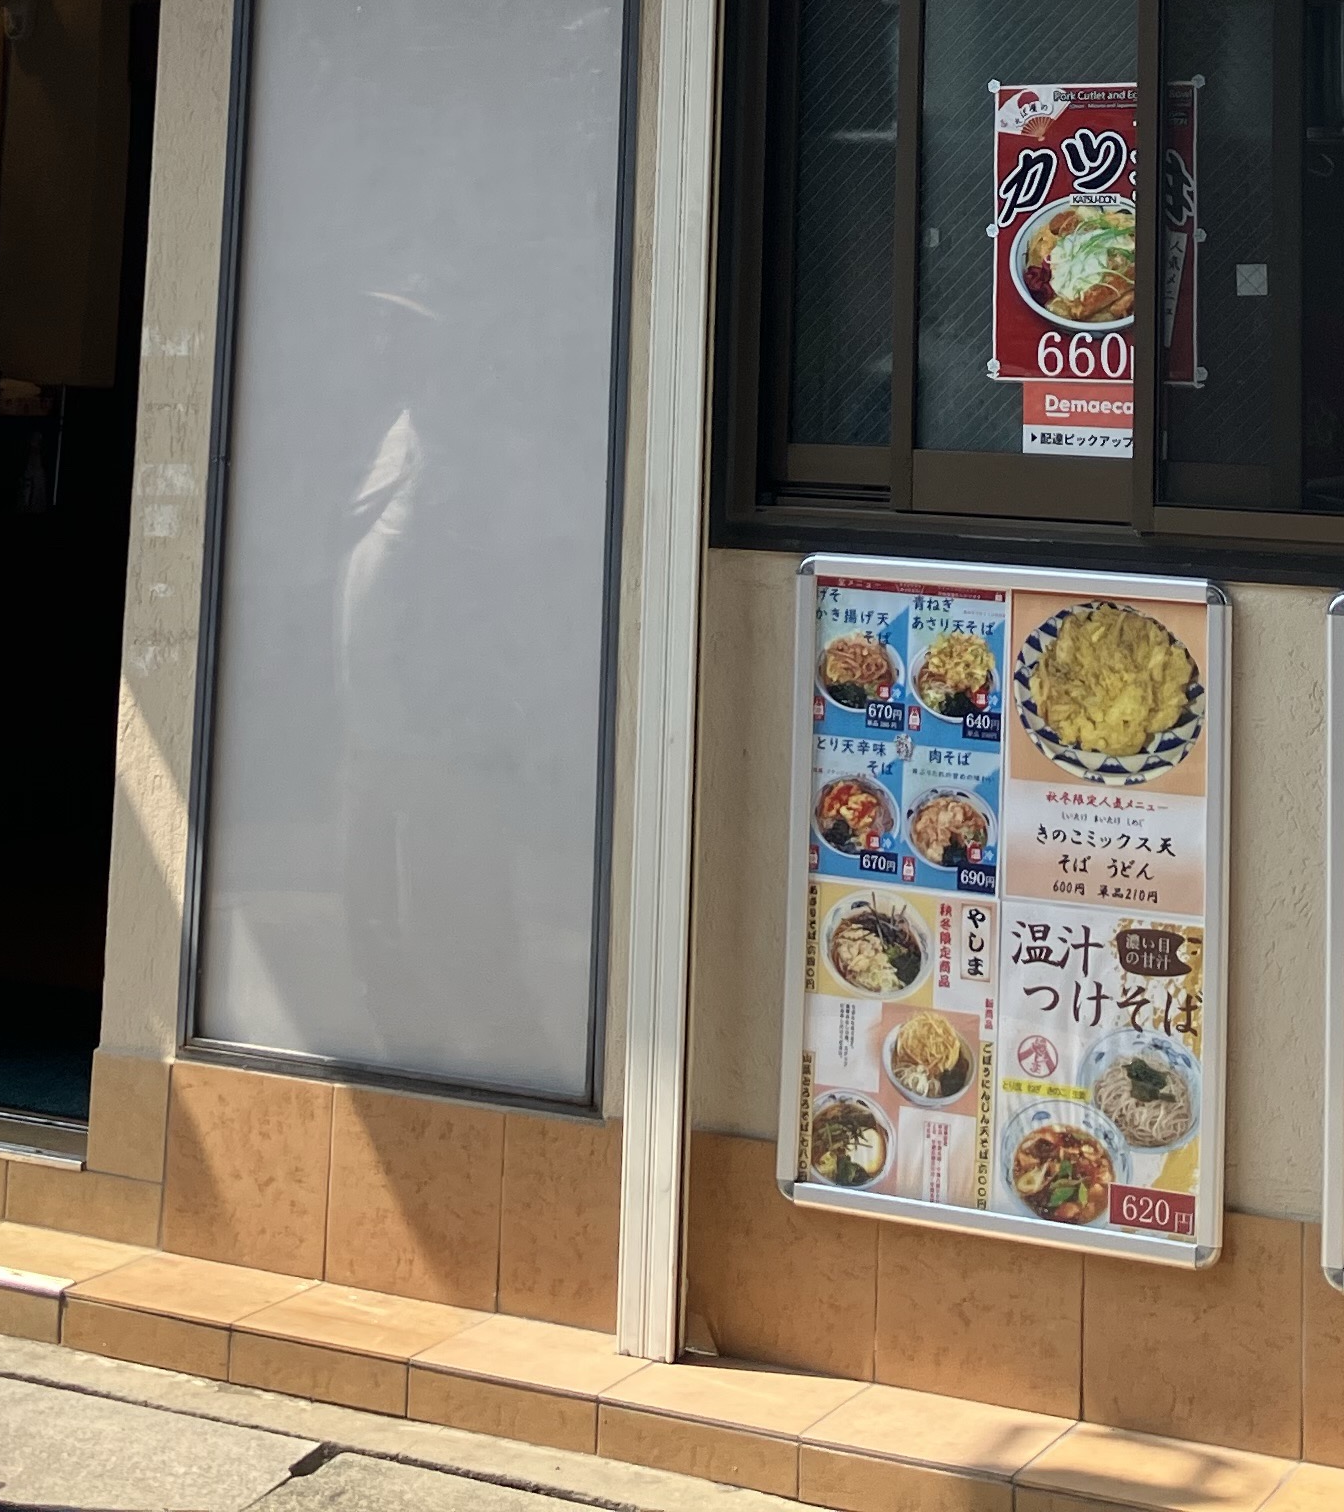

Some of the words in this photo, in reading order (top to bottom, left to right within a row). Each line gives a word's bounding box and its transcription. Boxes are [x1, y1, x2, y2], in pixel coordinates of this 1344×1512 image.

[1053, 90, 1075, 102] Pork
[1077, 90, 1105, 101] Cutlet
[1107, 90, 1126, 100] and
[1072, 195, 1117, 205] KATSU-DON
[1044, 393, 1135, 417] Demaeca
[913, 597, 954, 612] 青ねぎ
[816, 609, 890, 626] かき揚げ天
[911, 616, 995, 636] あさり天そば
[863, 630, 891, 645] そば
[868, 703, 902, 721] 670円
[966, 714, 1000, 731] 640円
[817, 737, 887, 757] とり天辛味
[929, 748, 972, 766] 肉そば
[867, 761, 894, 776] そば
[1046, 791, 1169, 812] 秋冬限定人気メニュー
[1036, 823, 1177, 858] きのこミックス天
[862, 855, 896, 872] 670円
[1058, 854, 1092, 874] そば
[1107, 857, 1155, 881] うどん
[960, 870, 995, 888] 690円
[1052, 880, 1086, 896] 600円
[1097, 884, 1158, 904] 単品210円
[967, 908, 986, 976] やしま
[1011, 920, 1104, 978] 温汁
[1126, 933, 1170, 954] 濃い目
[1126, 951, 1171, 971] の甘汁
[1023, 980, 1203, 1037] つけそば
[1122, 1194, 1194, 1235] 620円
